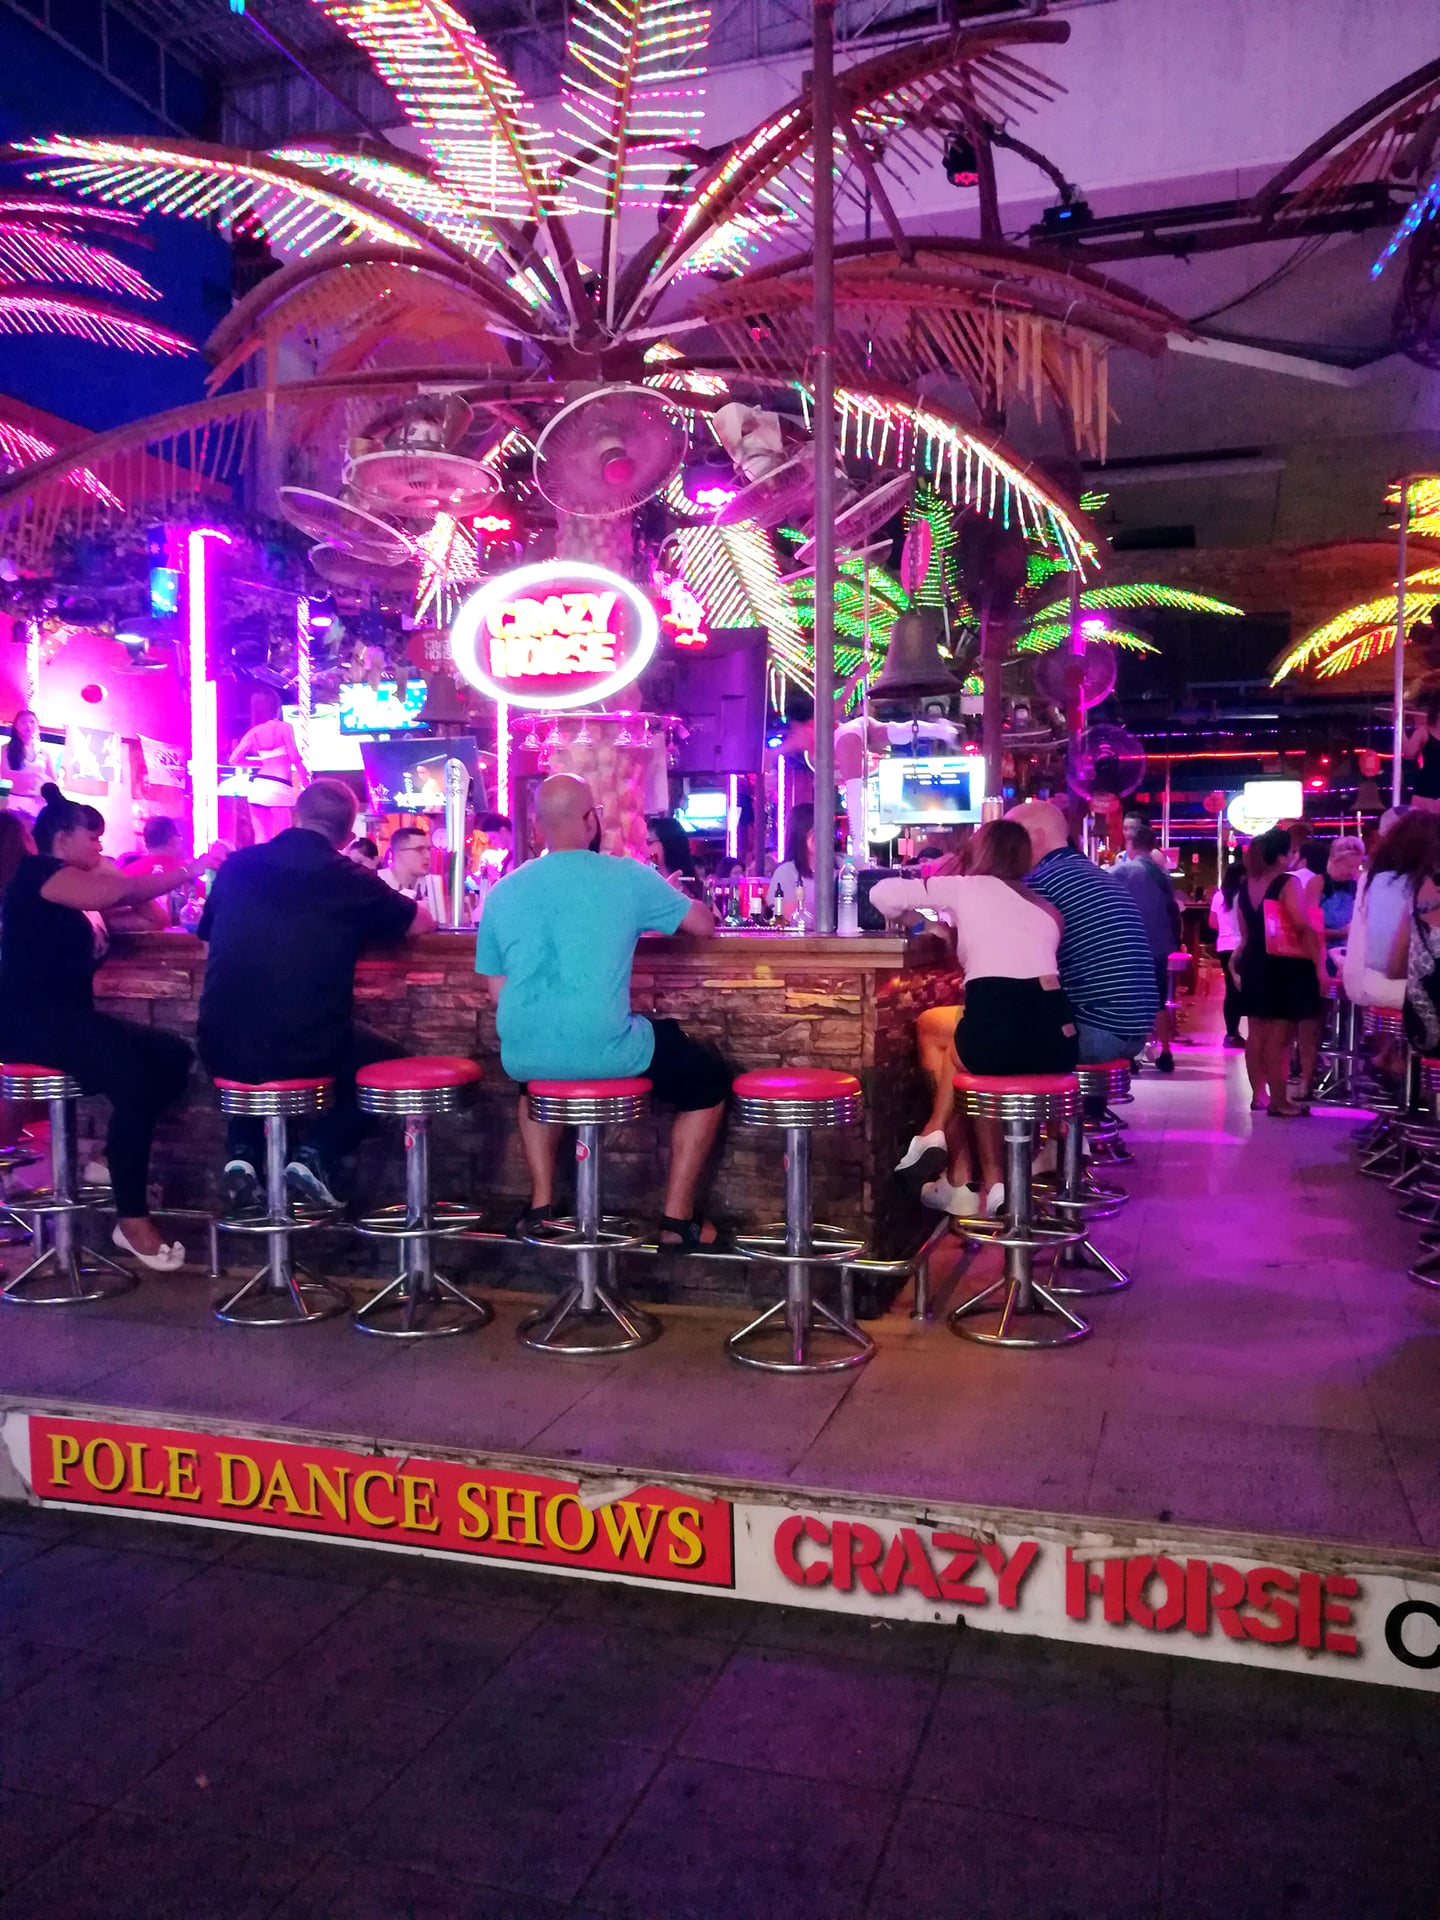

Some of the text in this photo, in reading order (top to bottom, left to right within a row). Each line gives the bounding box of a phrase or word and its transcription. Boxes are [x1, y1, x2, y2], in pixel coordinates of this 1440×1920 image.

[486, 591, 617, 640] CRAZY
[489, 631, 617, 678] HORSE
[47, 1433, 704, 1565] POLE DANCE SHOWS
[773, 1514, 1040, 1609] CRAZY
[1065, 1546, 1358, 1655] HORSE
